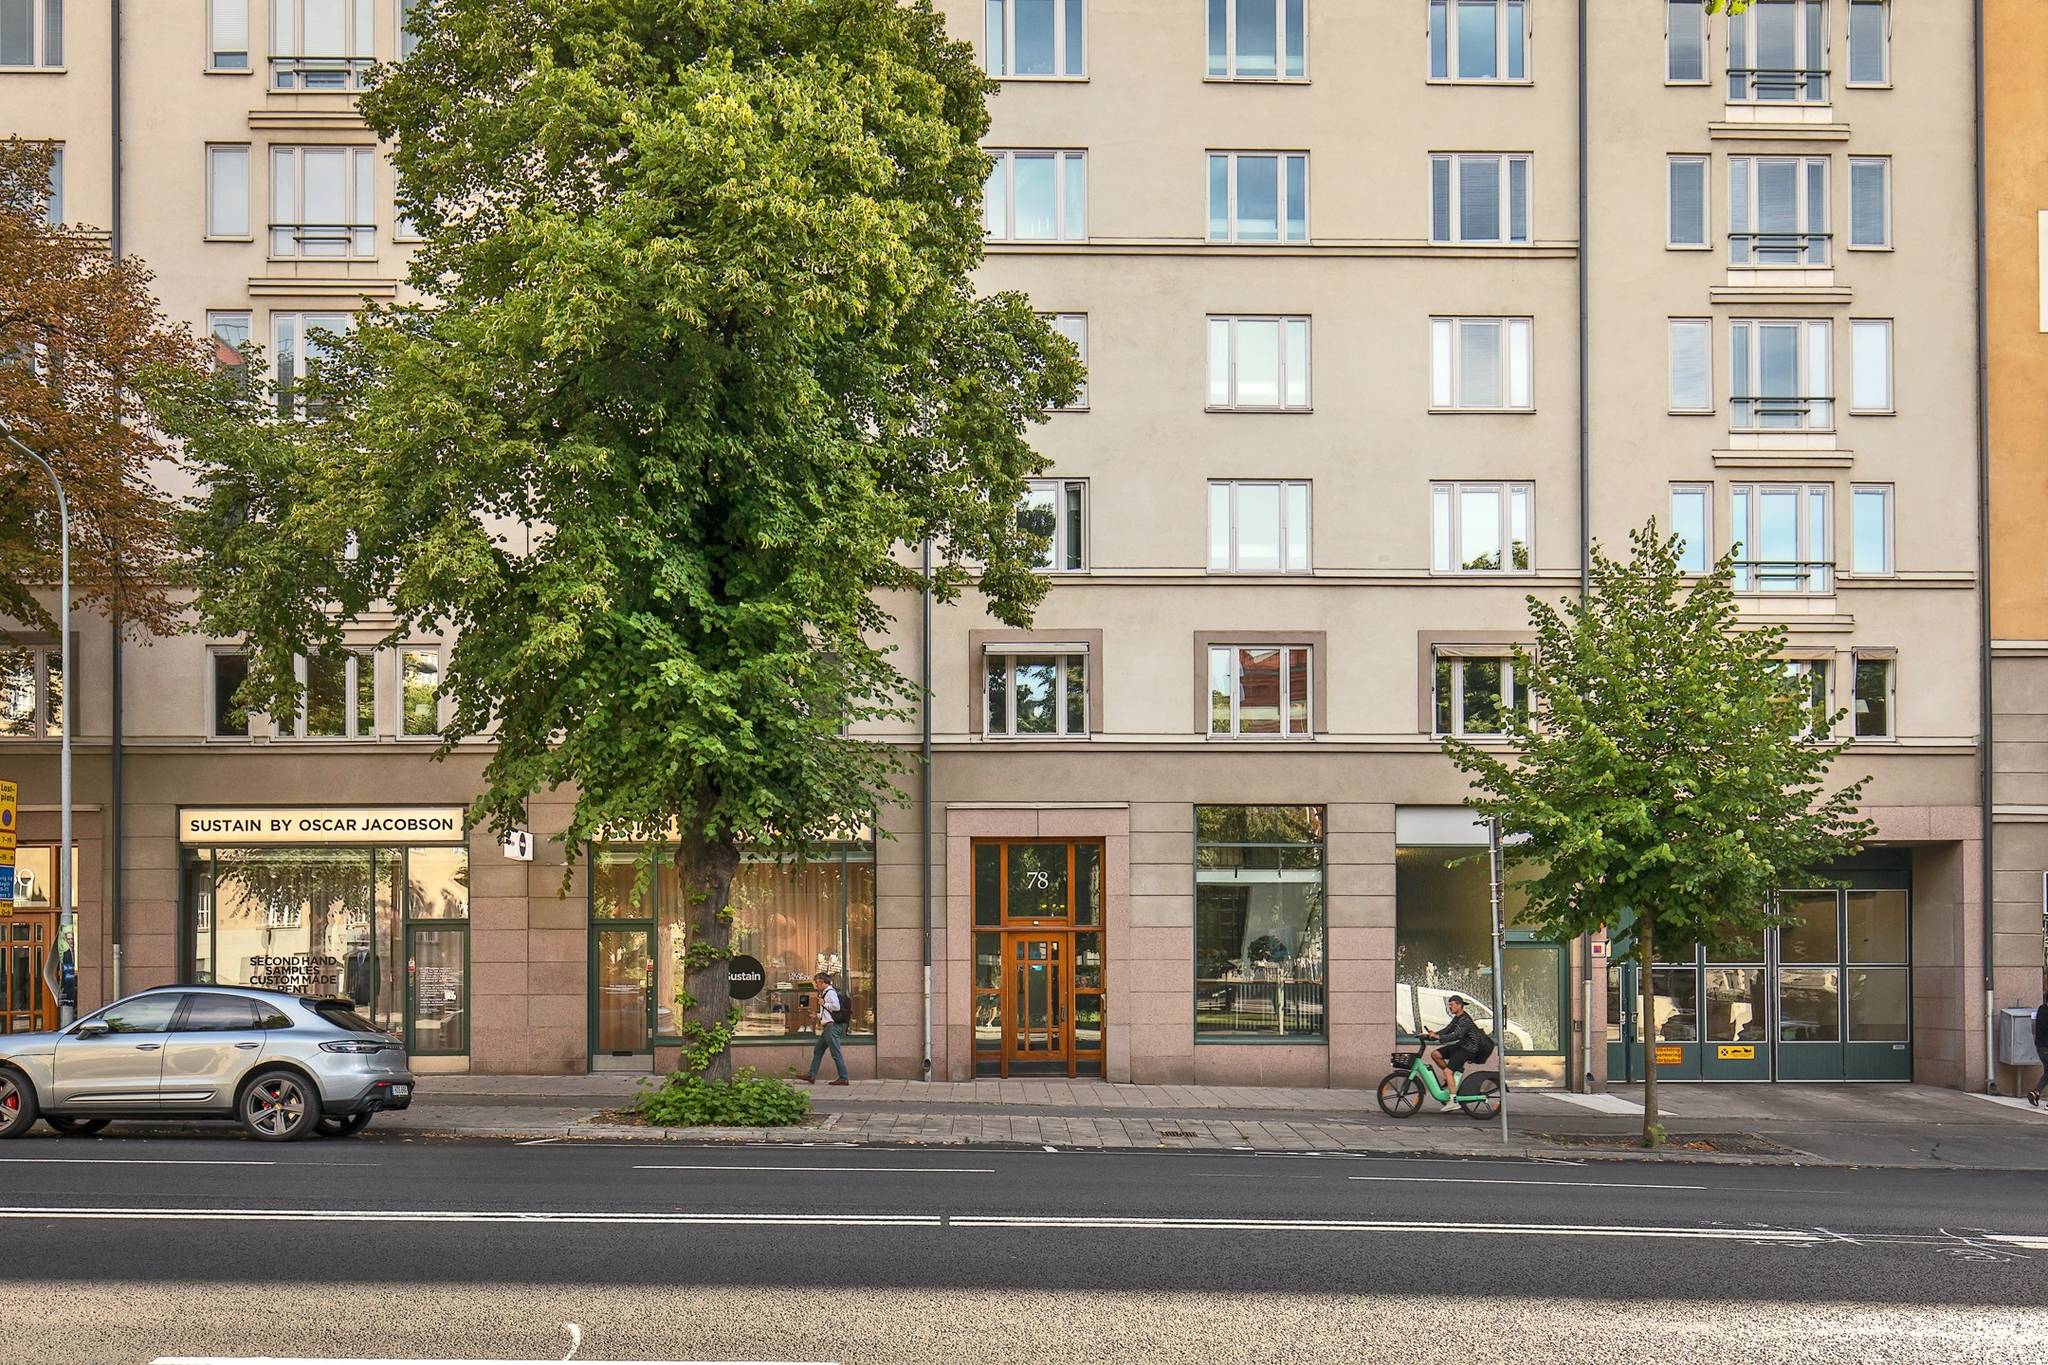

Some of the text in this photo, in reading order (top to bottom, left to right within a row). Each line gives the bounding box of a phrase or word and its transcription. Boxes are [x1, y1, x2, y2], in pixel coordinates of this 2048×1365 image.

[190, 818, 454, 832] SUSTAIN BY OSCAR JACOBSON
[1026, 871, 1049, 889] 78
[250, 956, 337, 966] SECOND HAND
[265, 966, 320, 975] SAMPLES
[250, 975, 337, 985] CUSTOM MADE
